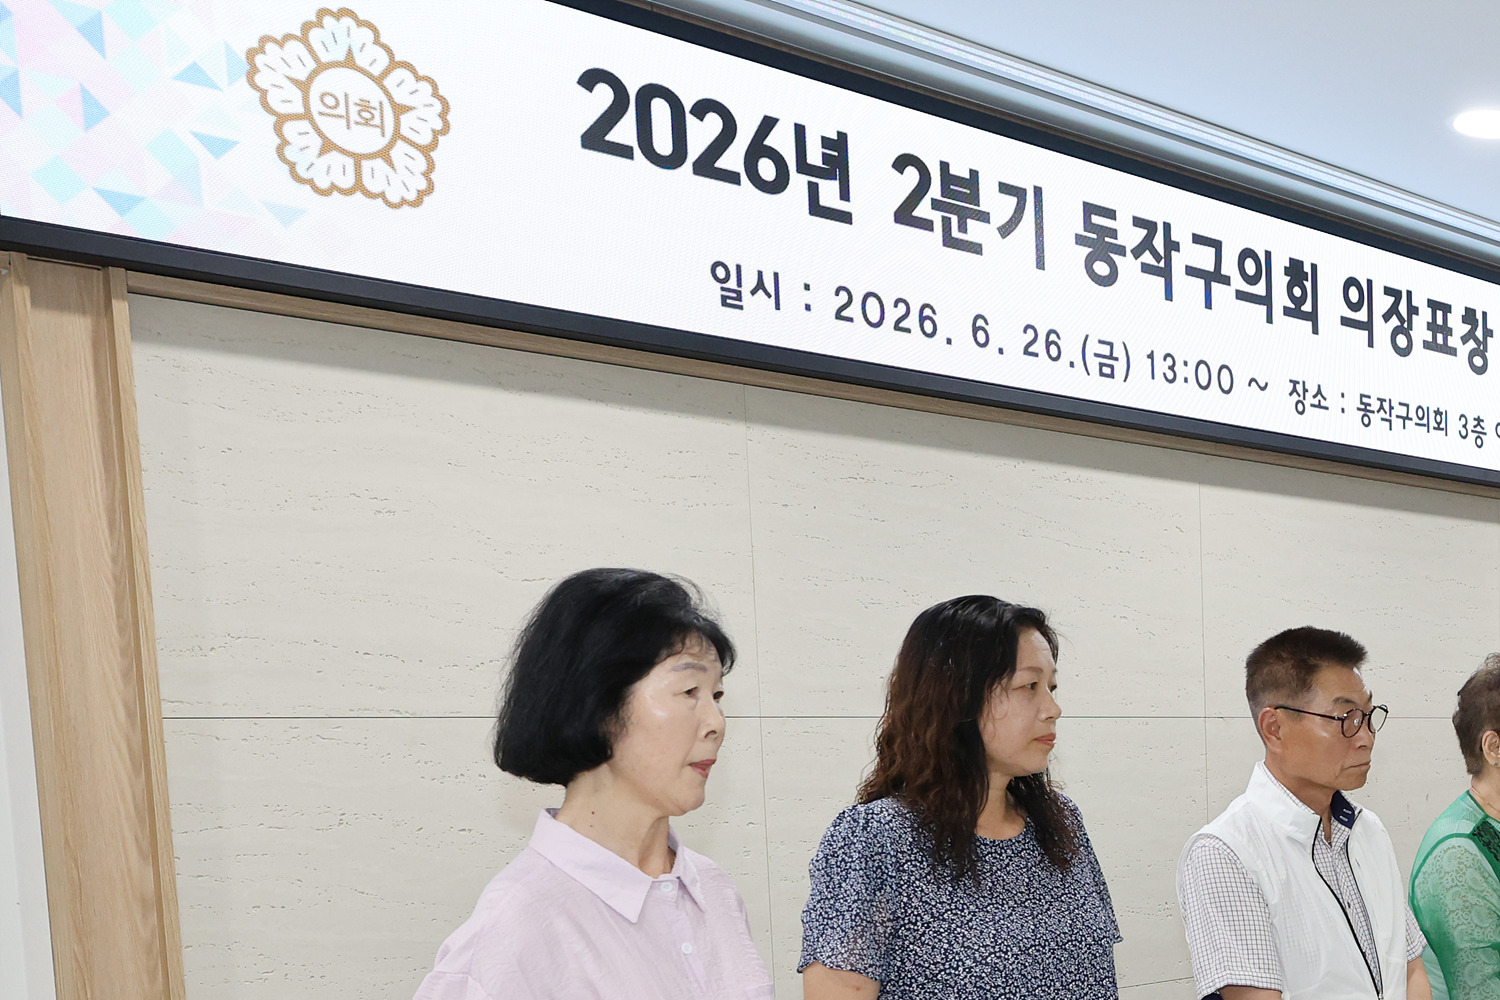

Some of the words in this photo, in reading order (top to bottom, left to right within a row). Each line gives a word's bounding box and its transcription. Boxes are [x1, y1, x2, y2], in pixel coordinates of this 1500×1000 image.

[317, 91, 386, 138] 의회
[576, 67, 853, 226] 2026년
[891, 152, 1046, 271] 2분기
[1074, 200, 1319, 336] 동작구의회
[1340, 276, 1494, 376] 의장표창
[710, 260, 781, 311] 일시
[834, 285, 952, 346] 2026.
[971, 313, 1004, 356] 6.
[1022, 323, 1131, 383] 26.(금)
[1146, 349, 1234, 395] 13:00
[1288, 378, 1330, 416] 장소
[1356, 393, 1448, 437] 동작구의회
[1458, 413, 1488, 449] 3층
